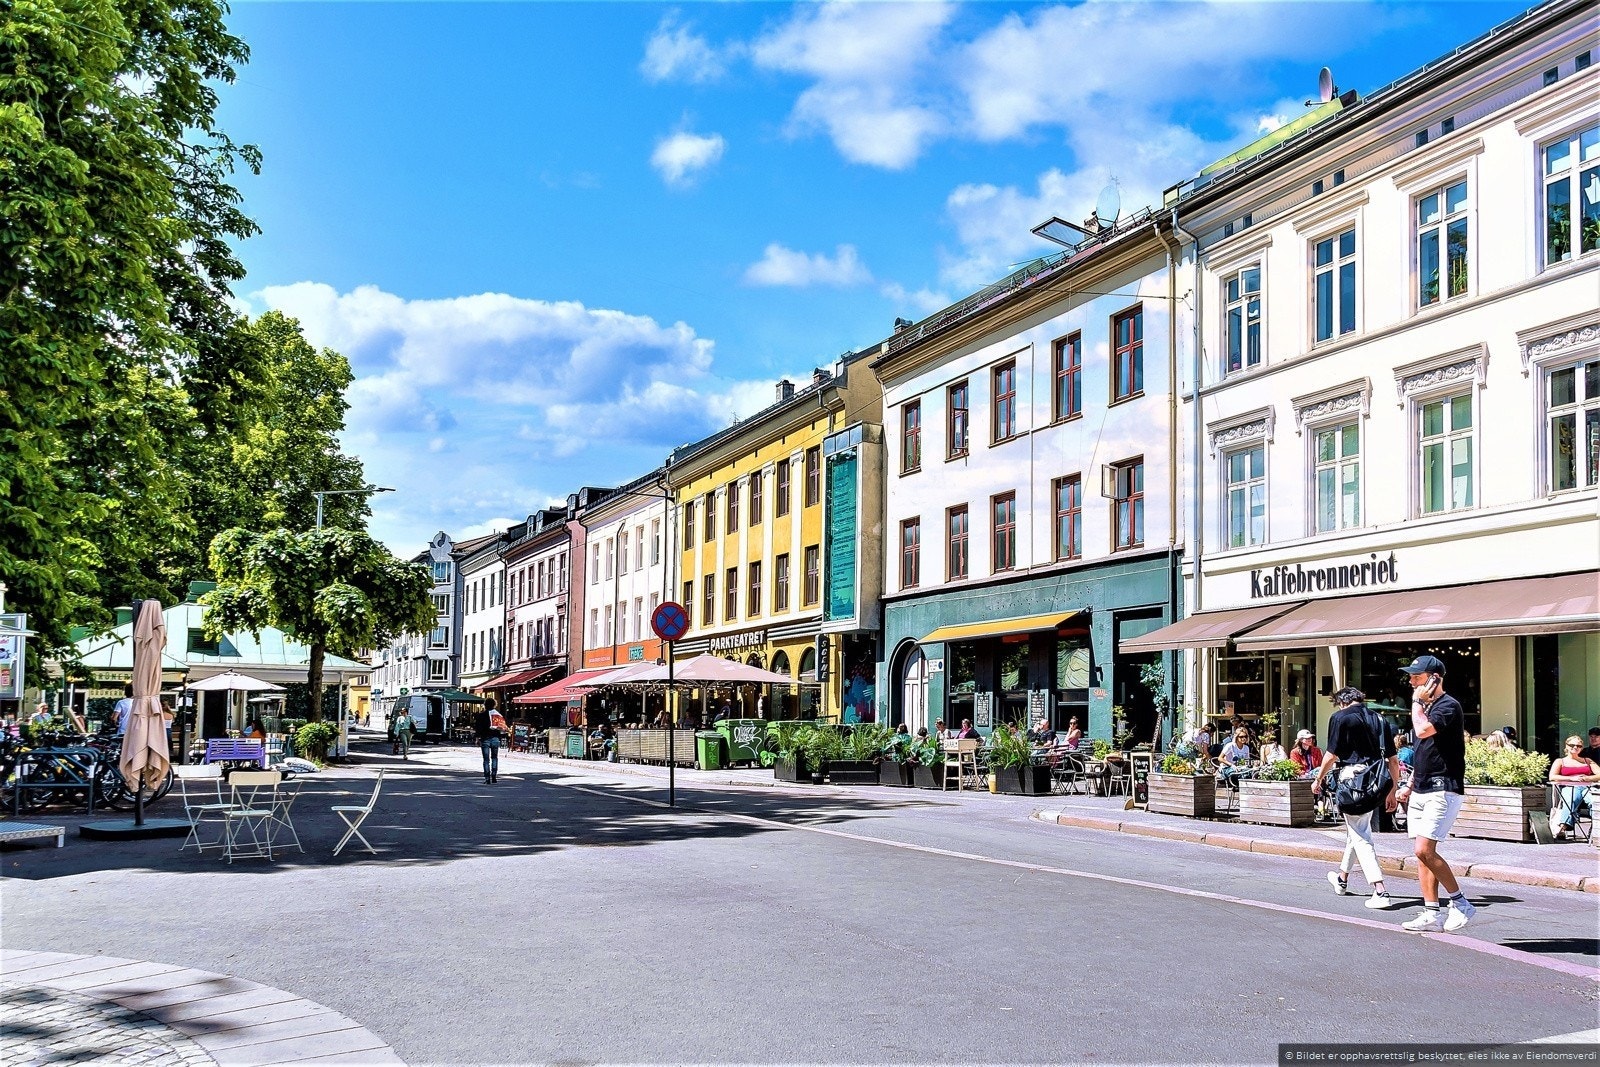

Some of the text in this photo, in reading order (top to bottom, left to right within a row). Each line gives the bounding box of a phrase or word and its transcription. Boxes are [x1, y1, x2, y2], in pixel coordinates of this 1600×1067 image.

[1251, 551, 1398, 598] Kaffebrenneriet
[710, 630, 765, 650] PARKTEATRET
[821, 640, 829, 679] SCENE
